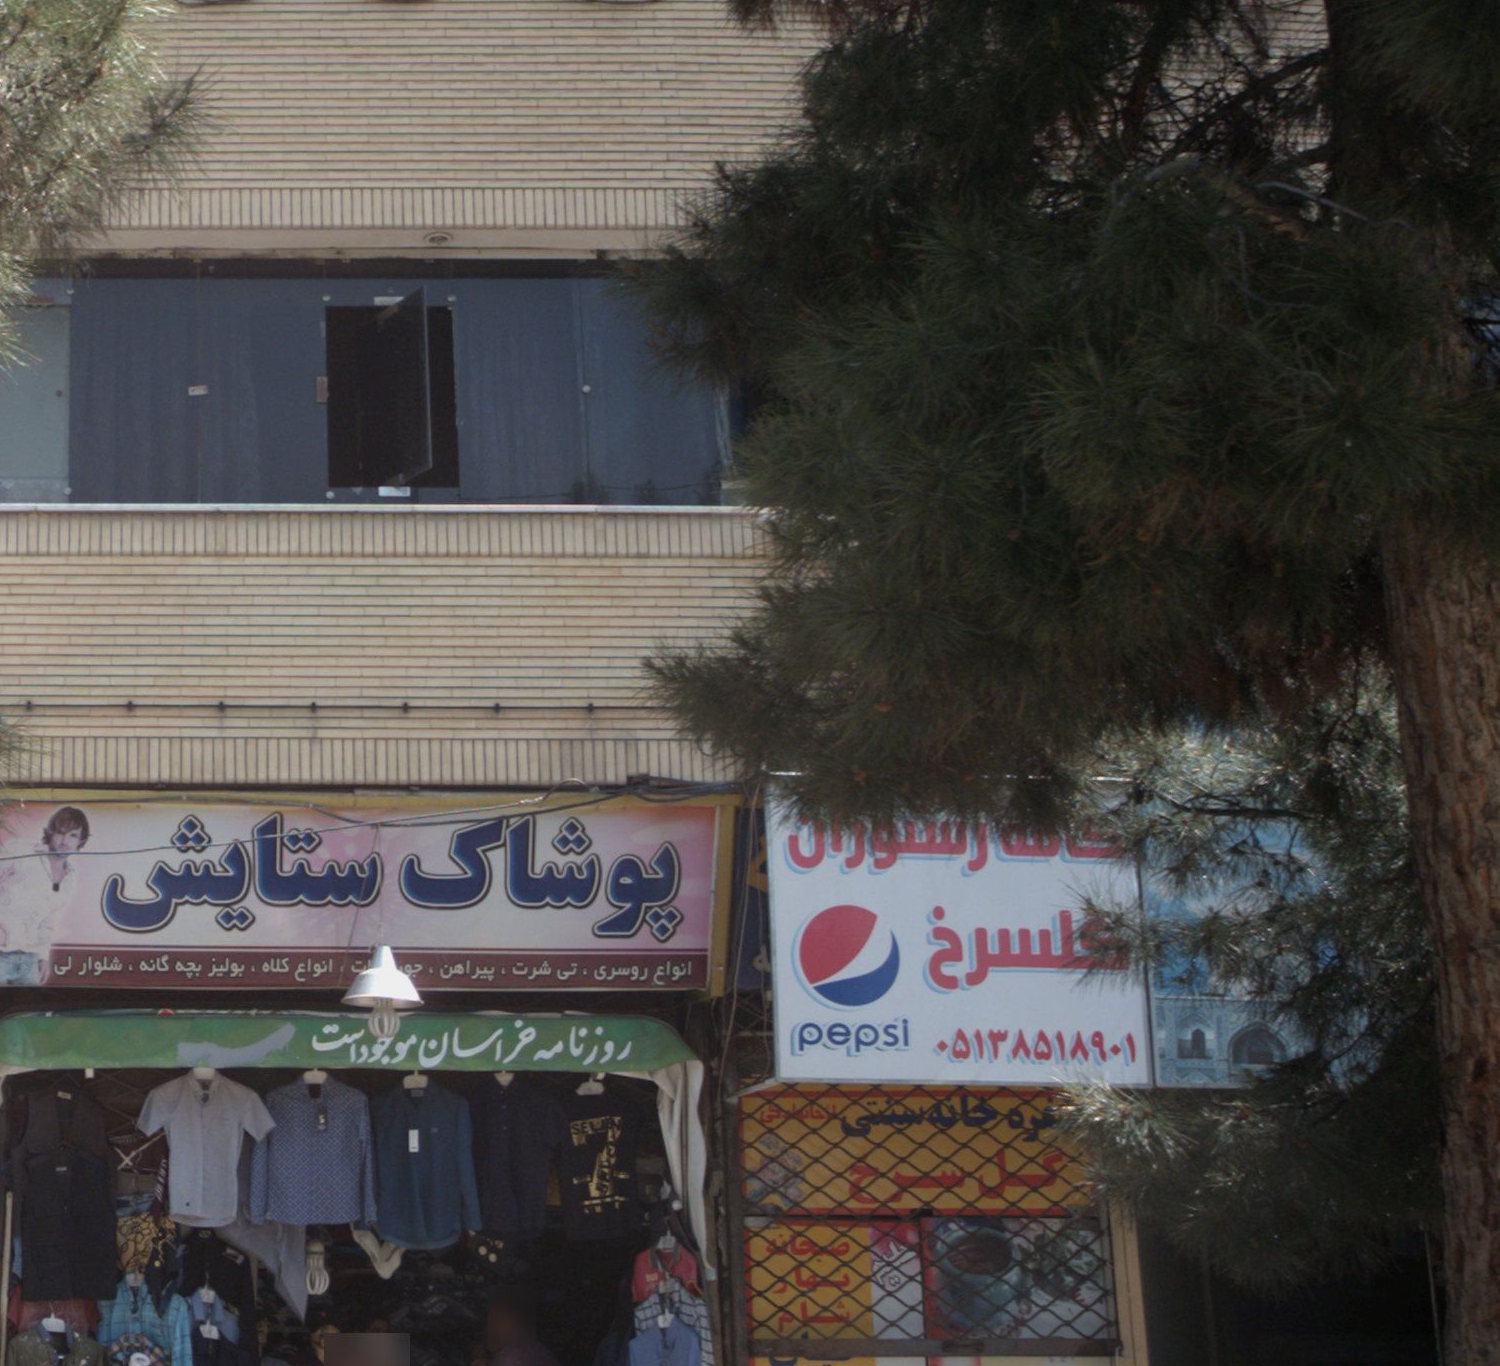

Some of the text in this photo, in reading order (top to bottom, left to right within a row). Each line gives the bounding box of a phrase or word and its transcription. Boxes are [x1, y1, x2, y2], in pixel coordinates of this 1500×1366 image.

[100, 811, 383, 933] ستایش
[399, 813, 684, 942] پوشاک
[52, 955, 73, 975] لی
[78, 955, 123, 977] شلوار
[139, 955, 170, 973] گانه
[173, 960, 203, 979] بچه
[207, 957, 246, 978] بولیز
[261, 957, 290, 974] کلاه
[294, 959, 334, 982] انواع
[439, 960, 496, 981] پیراهن
[512, 960, 552, 980] شرت
[557, 962, 578, 981] تی
[593, 962, 649, 982] روسری
[652, 960, 693, 986] انواع
[417, 1018, 538, 1068] خراسان
[533, 1024, 633, 1067] روزنامه
[796, 1018, 910, 1053] pepsi
[935, 1028, 1137, 1065] ۰۵۱۳۸۵۱۸۹۰۱
[1005, 1094, 1070, 1143] فره
[979, 1148, 1064, 1199] گل
